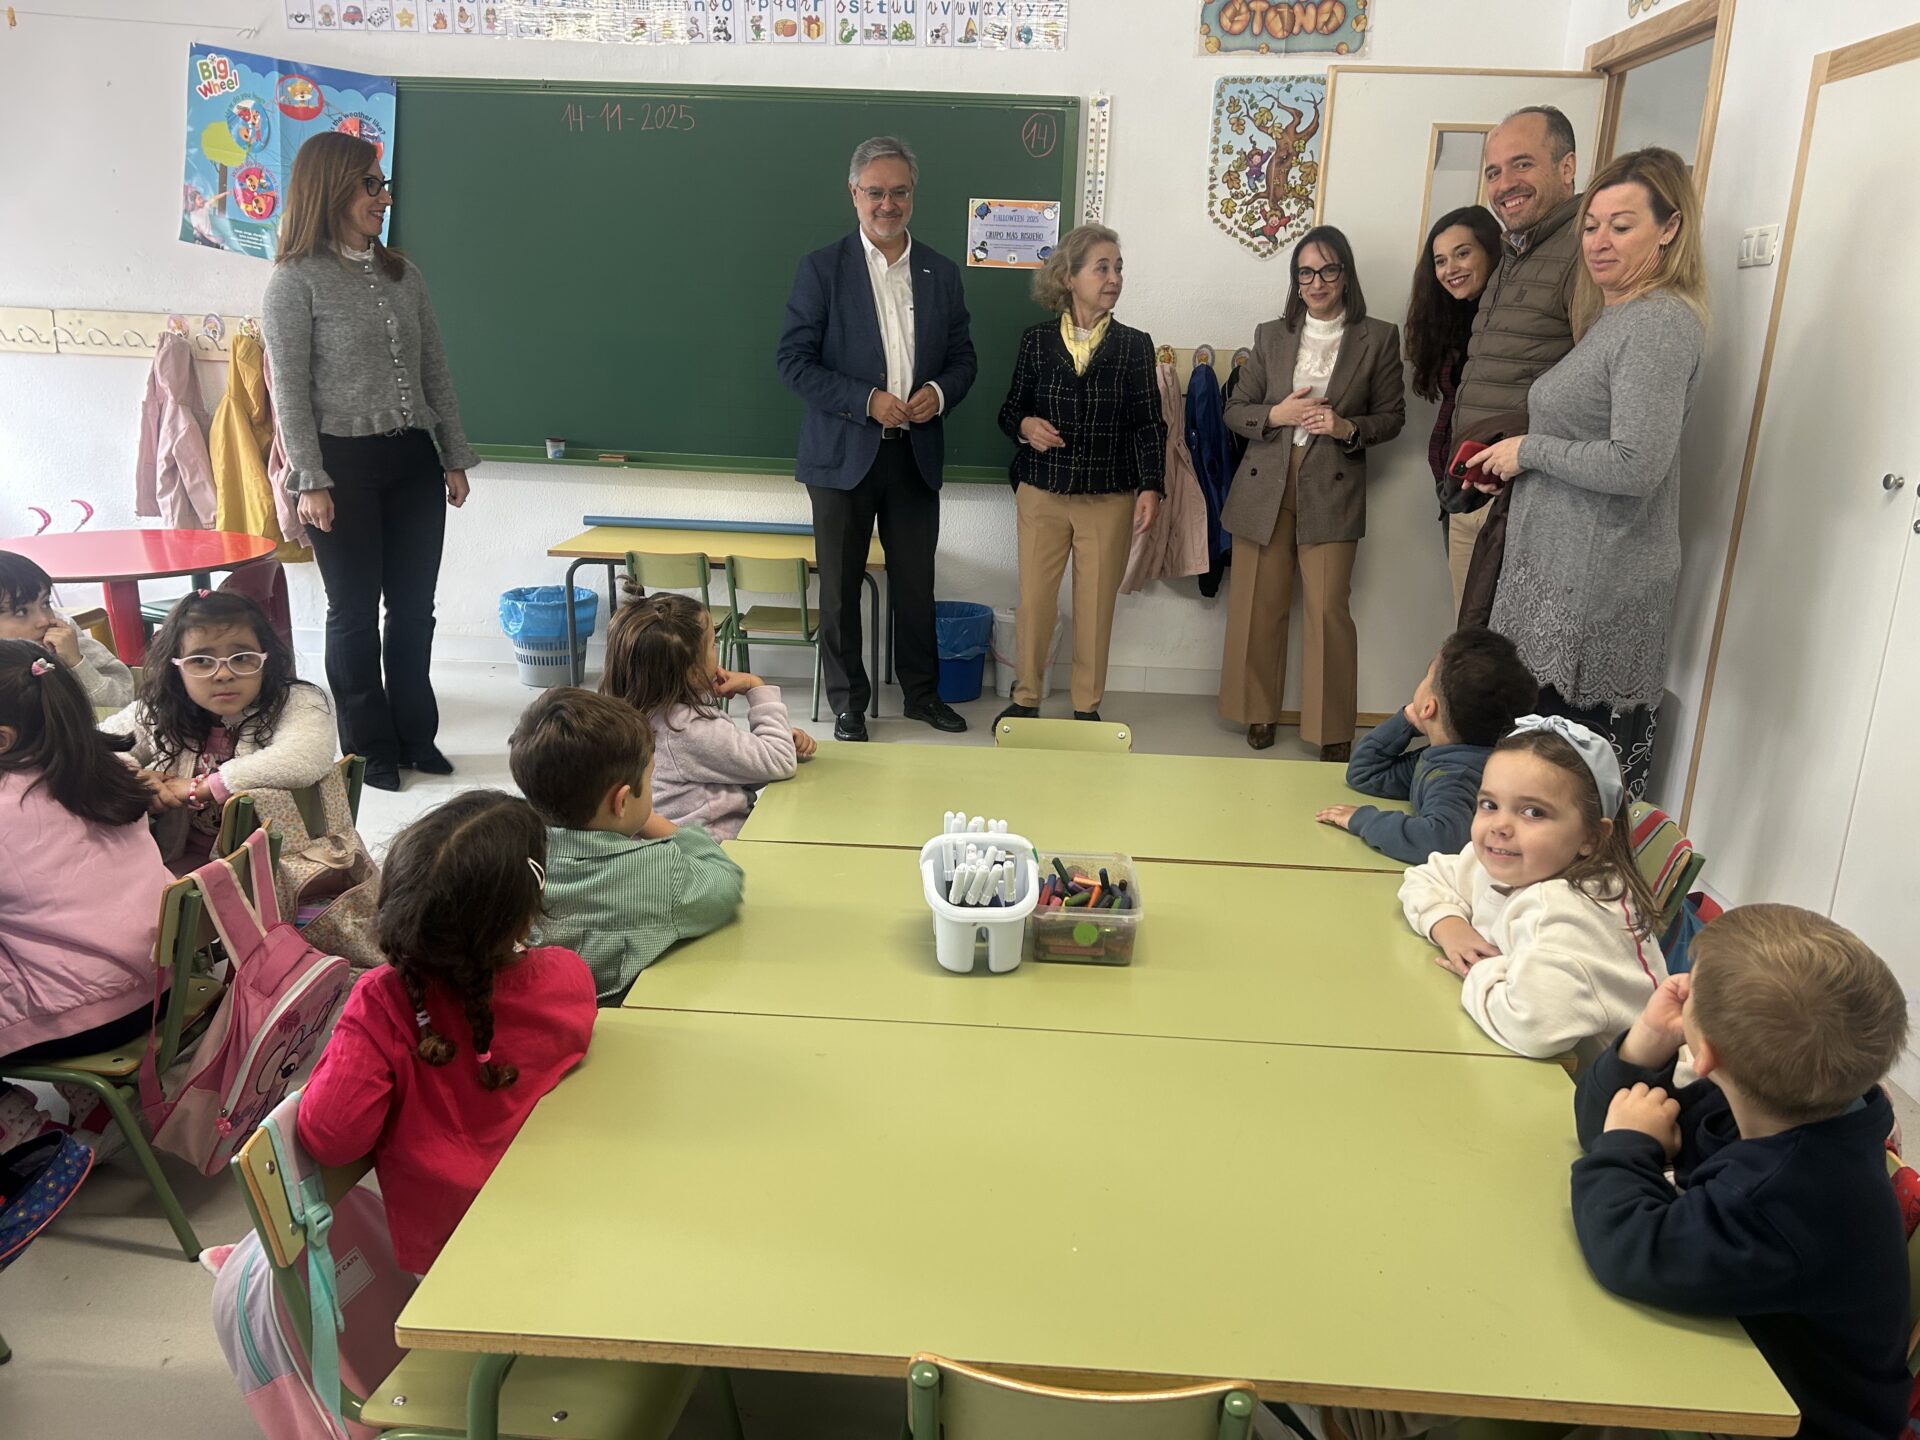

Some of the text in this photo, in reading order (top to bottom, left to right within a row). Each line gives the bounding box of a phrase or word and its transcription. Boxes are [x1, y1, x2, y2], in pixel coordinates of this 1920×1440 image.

[849, 0, 859, 13] s
[877, 0, 886, 13] t
[905, 0, 915, 13] u
[198, 55, 229, 80] Big
[198, 71, 239, 98] Wheel
[343, 111, 373, 122] weather
[1025, 122, 1048, 150] 14
[342, 1255, 359, 1271] CATS
